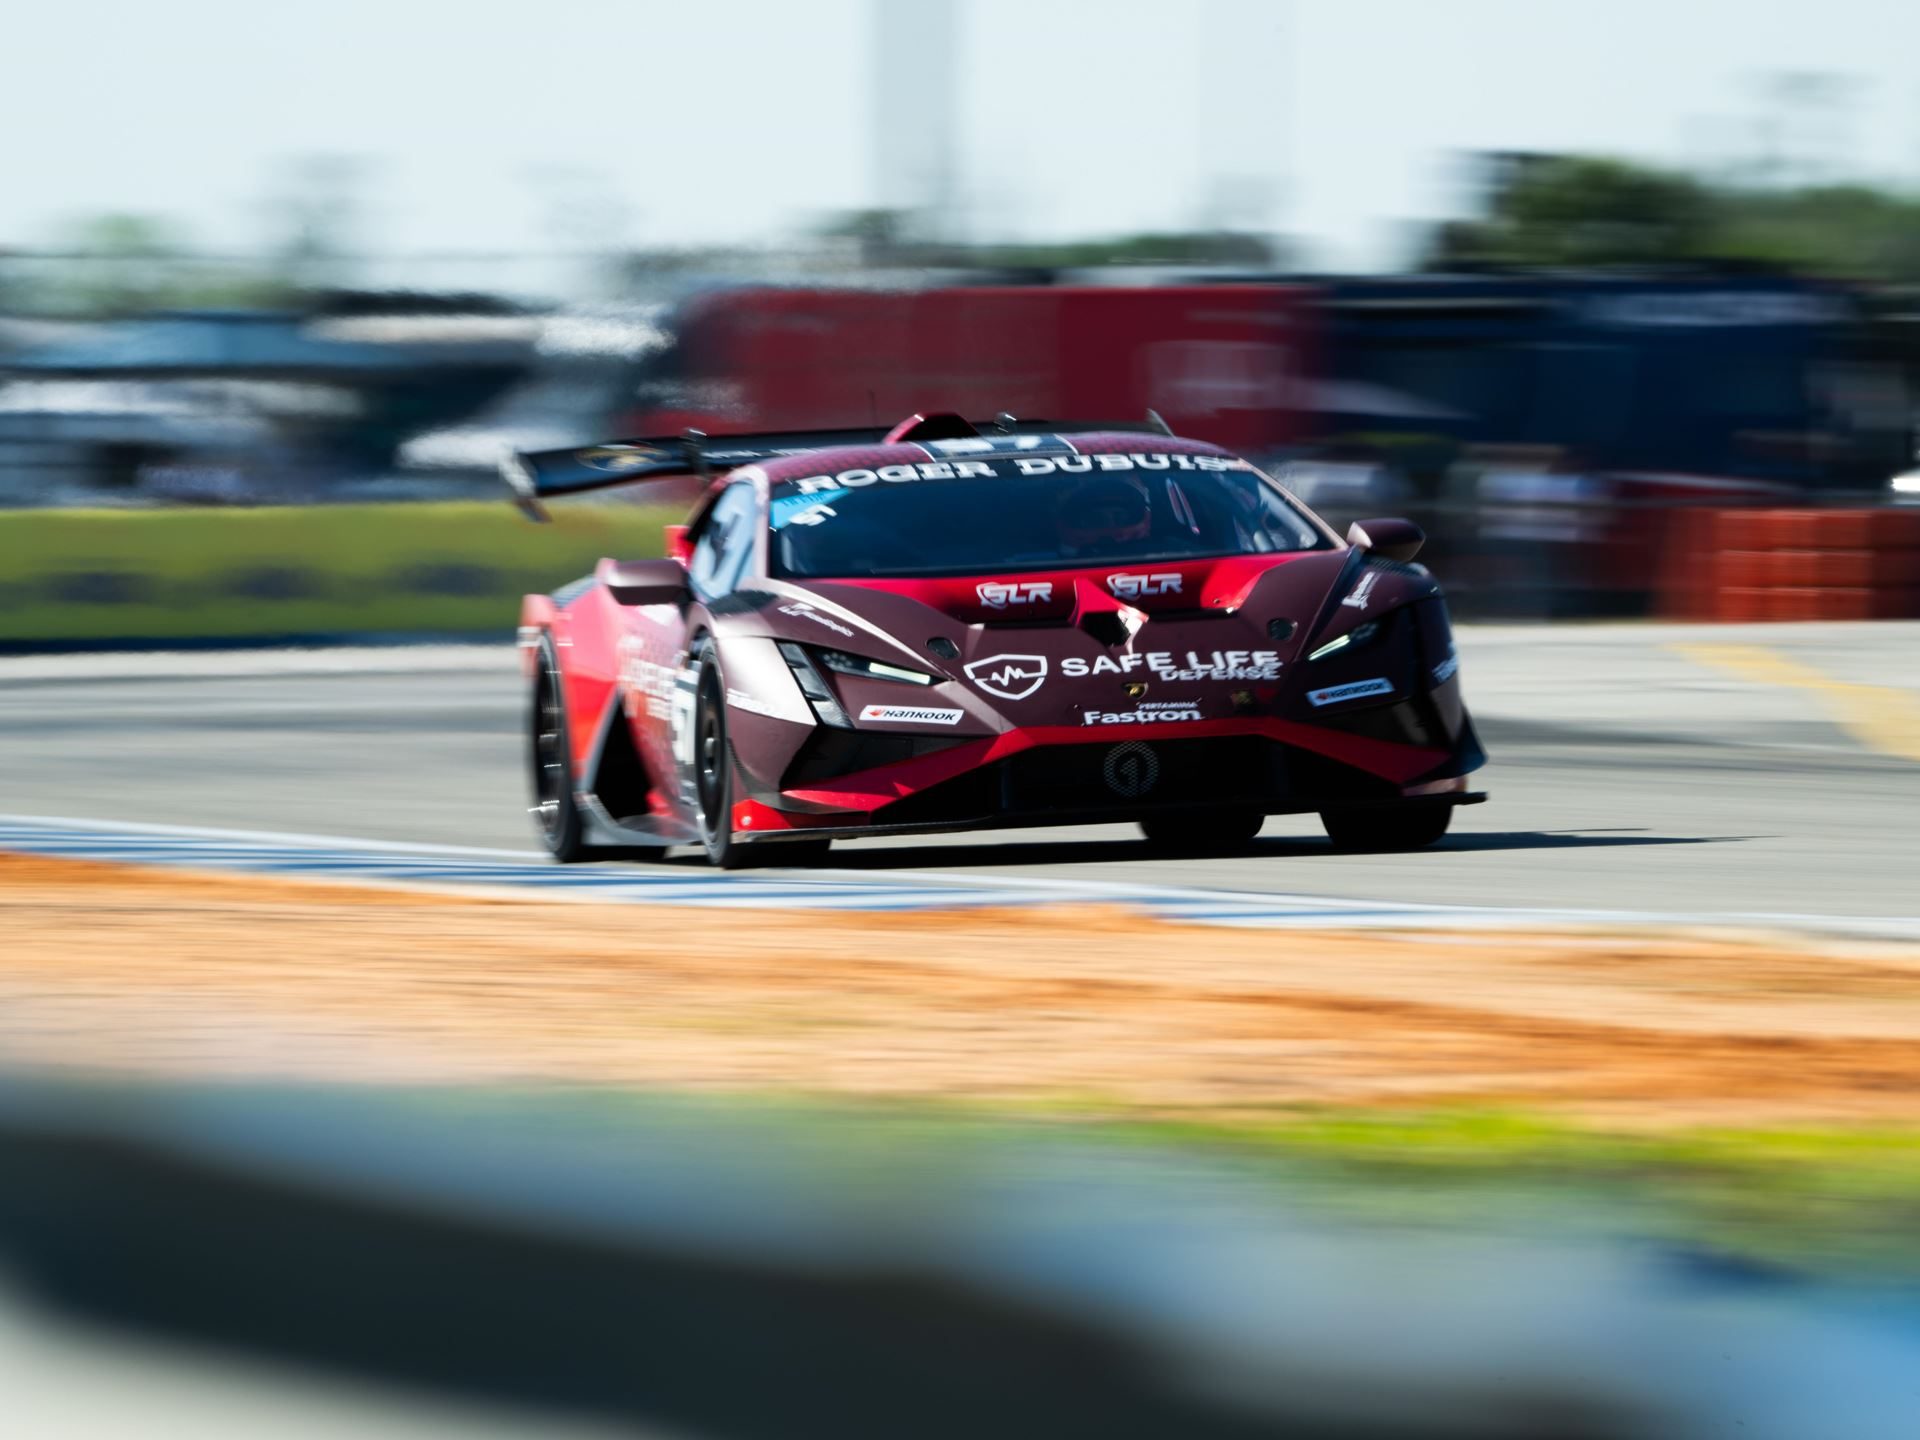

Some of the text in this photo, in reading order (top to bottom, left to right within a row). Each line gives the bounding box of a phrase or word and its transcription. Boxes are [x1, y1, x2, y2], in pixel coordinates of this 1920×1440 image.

[796, 453, 1228, 495] ROGER DUBUIS
[977, 581, 1053, 608] SLR
[1108, 572, 1184, 599] SLR
[1060, 650, 1284, 677] SAFE LIFE
[1159, 664, 1281, 681] DEFENSE
[1083, 709, 1202, 725] Fastron
